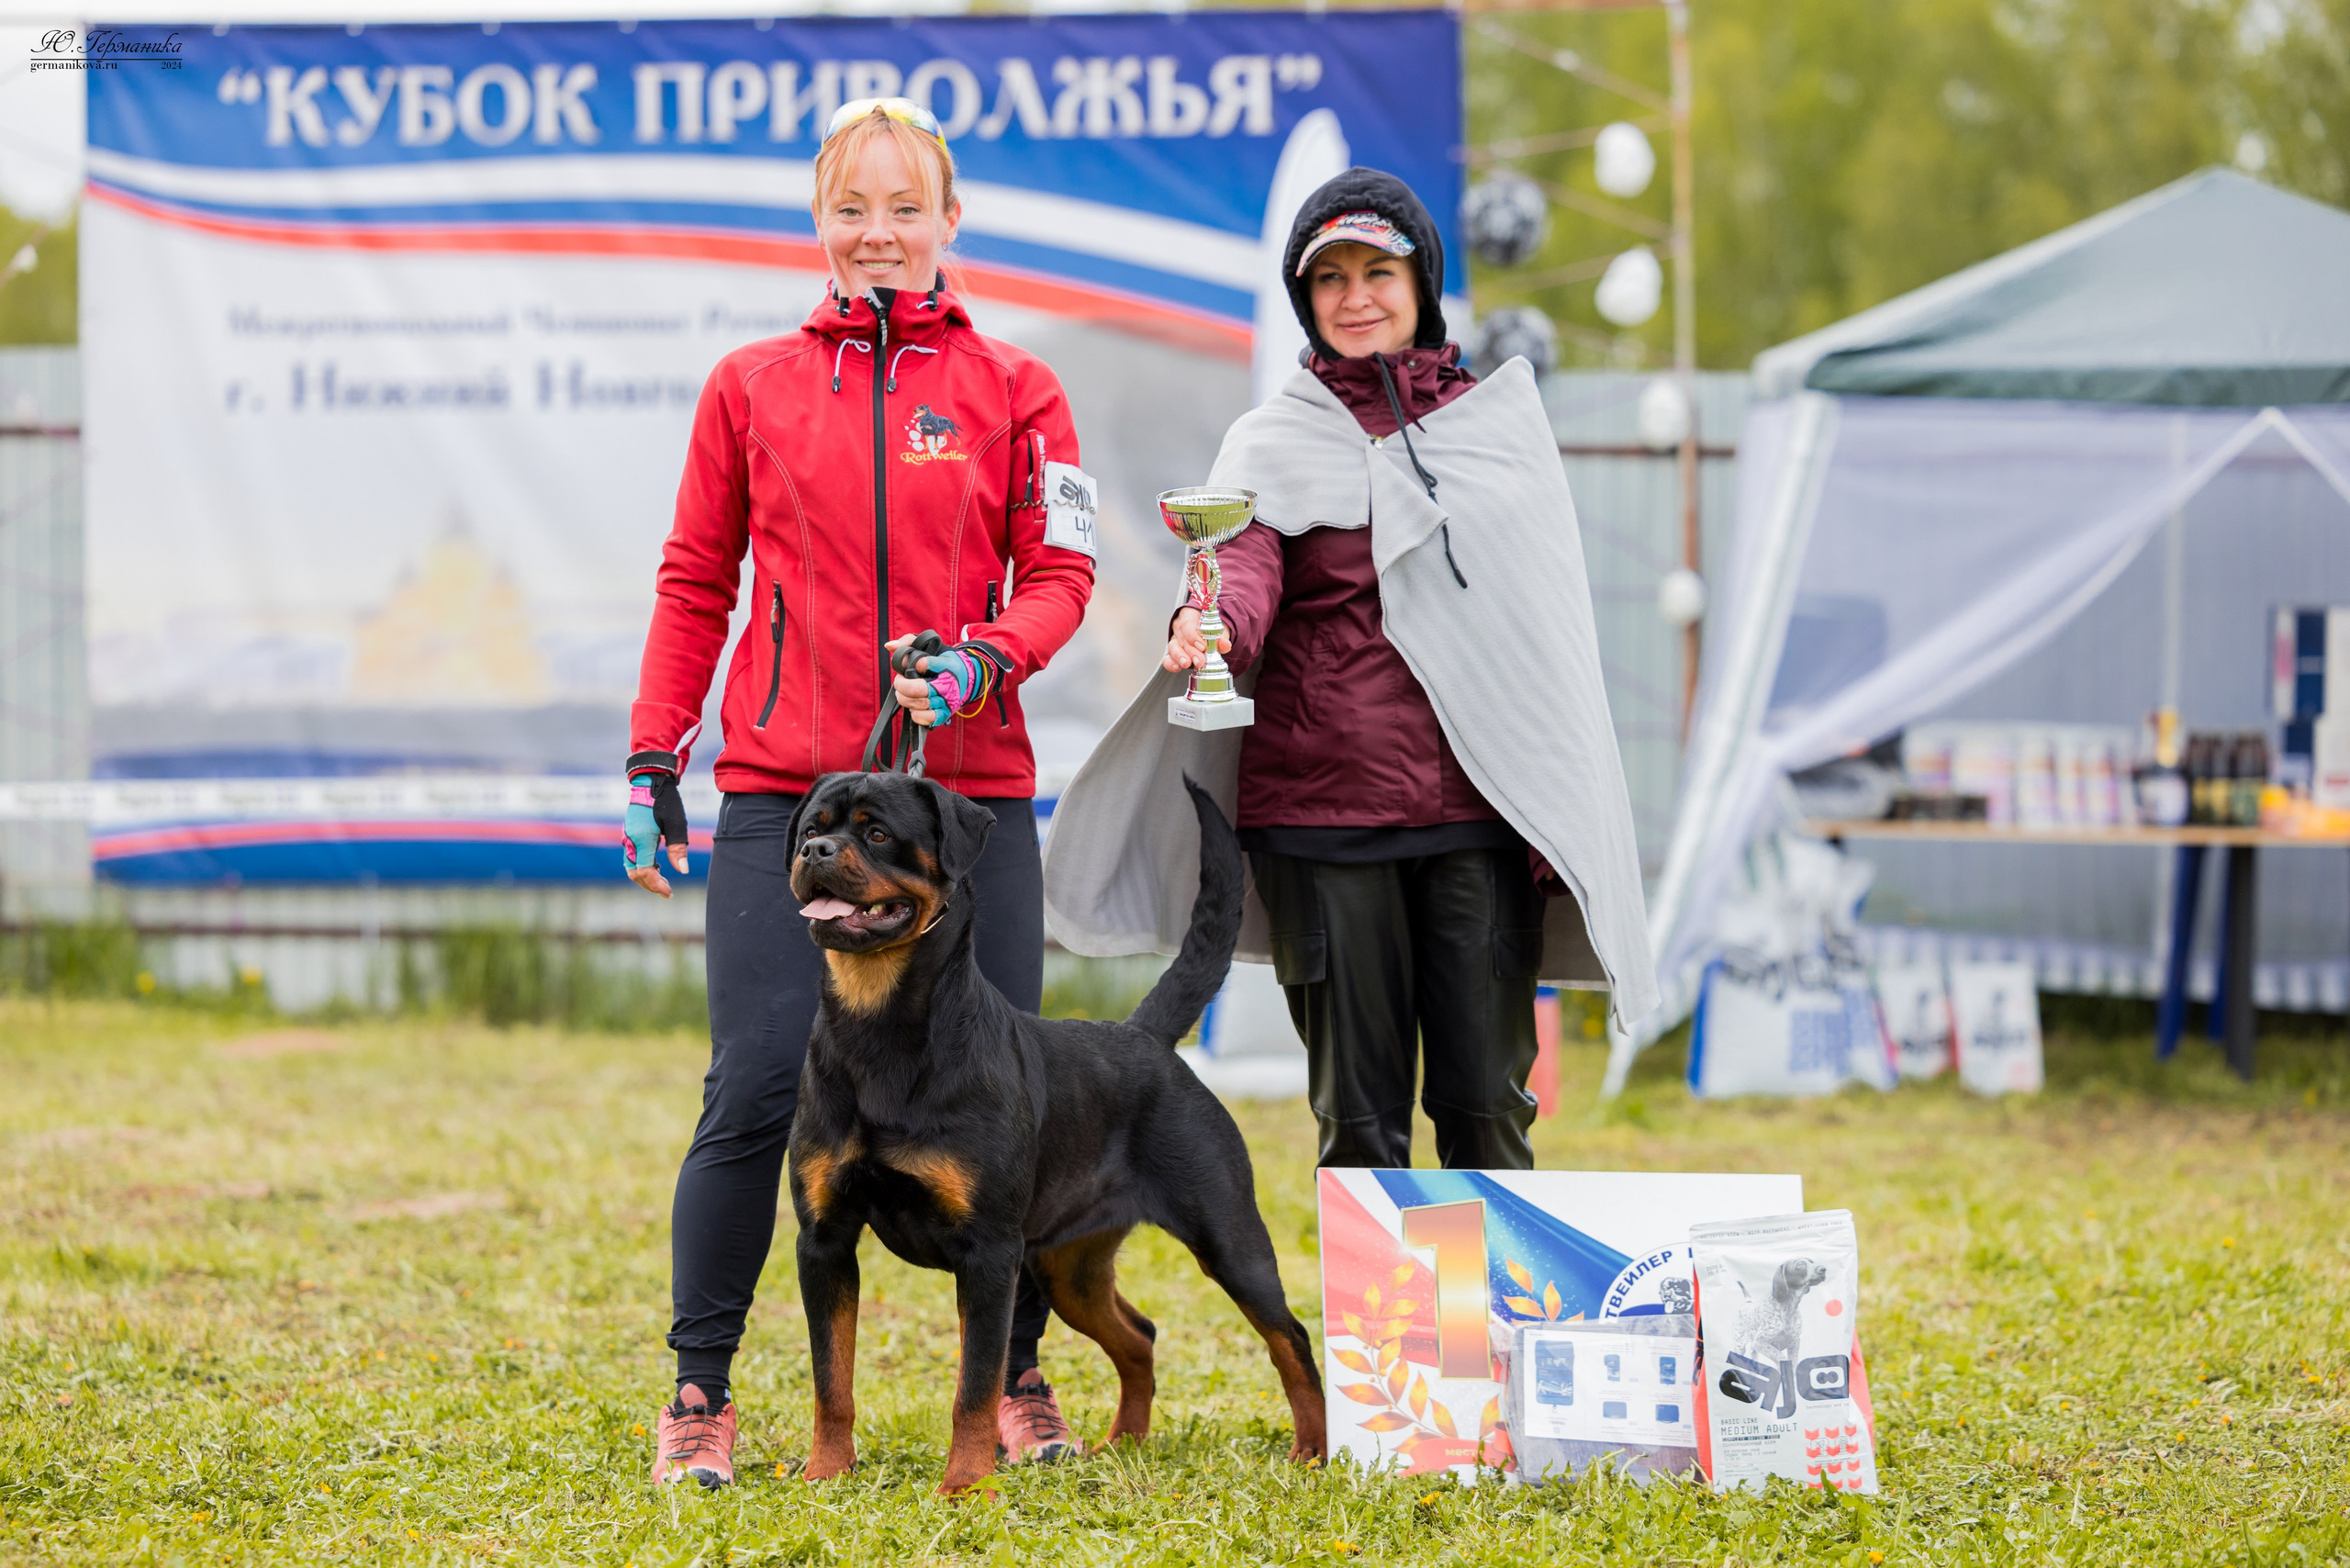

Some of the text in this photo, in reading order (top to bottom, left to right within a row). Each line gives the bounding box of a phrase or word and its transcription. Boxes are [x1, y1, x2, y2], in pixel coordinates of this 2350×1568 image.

[901, 450, 968, 465] Rottweiler
[1401, 1198, 1494, 1380] 1
[1720, 1422, 1797, 1436] MEDIUM ADULT
